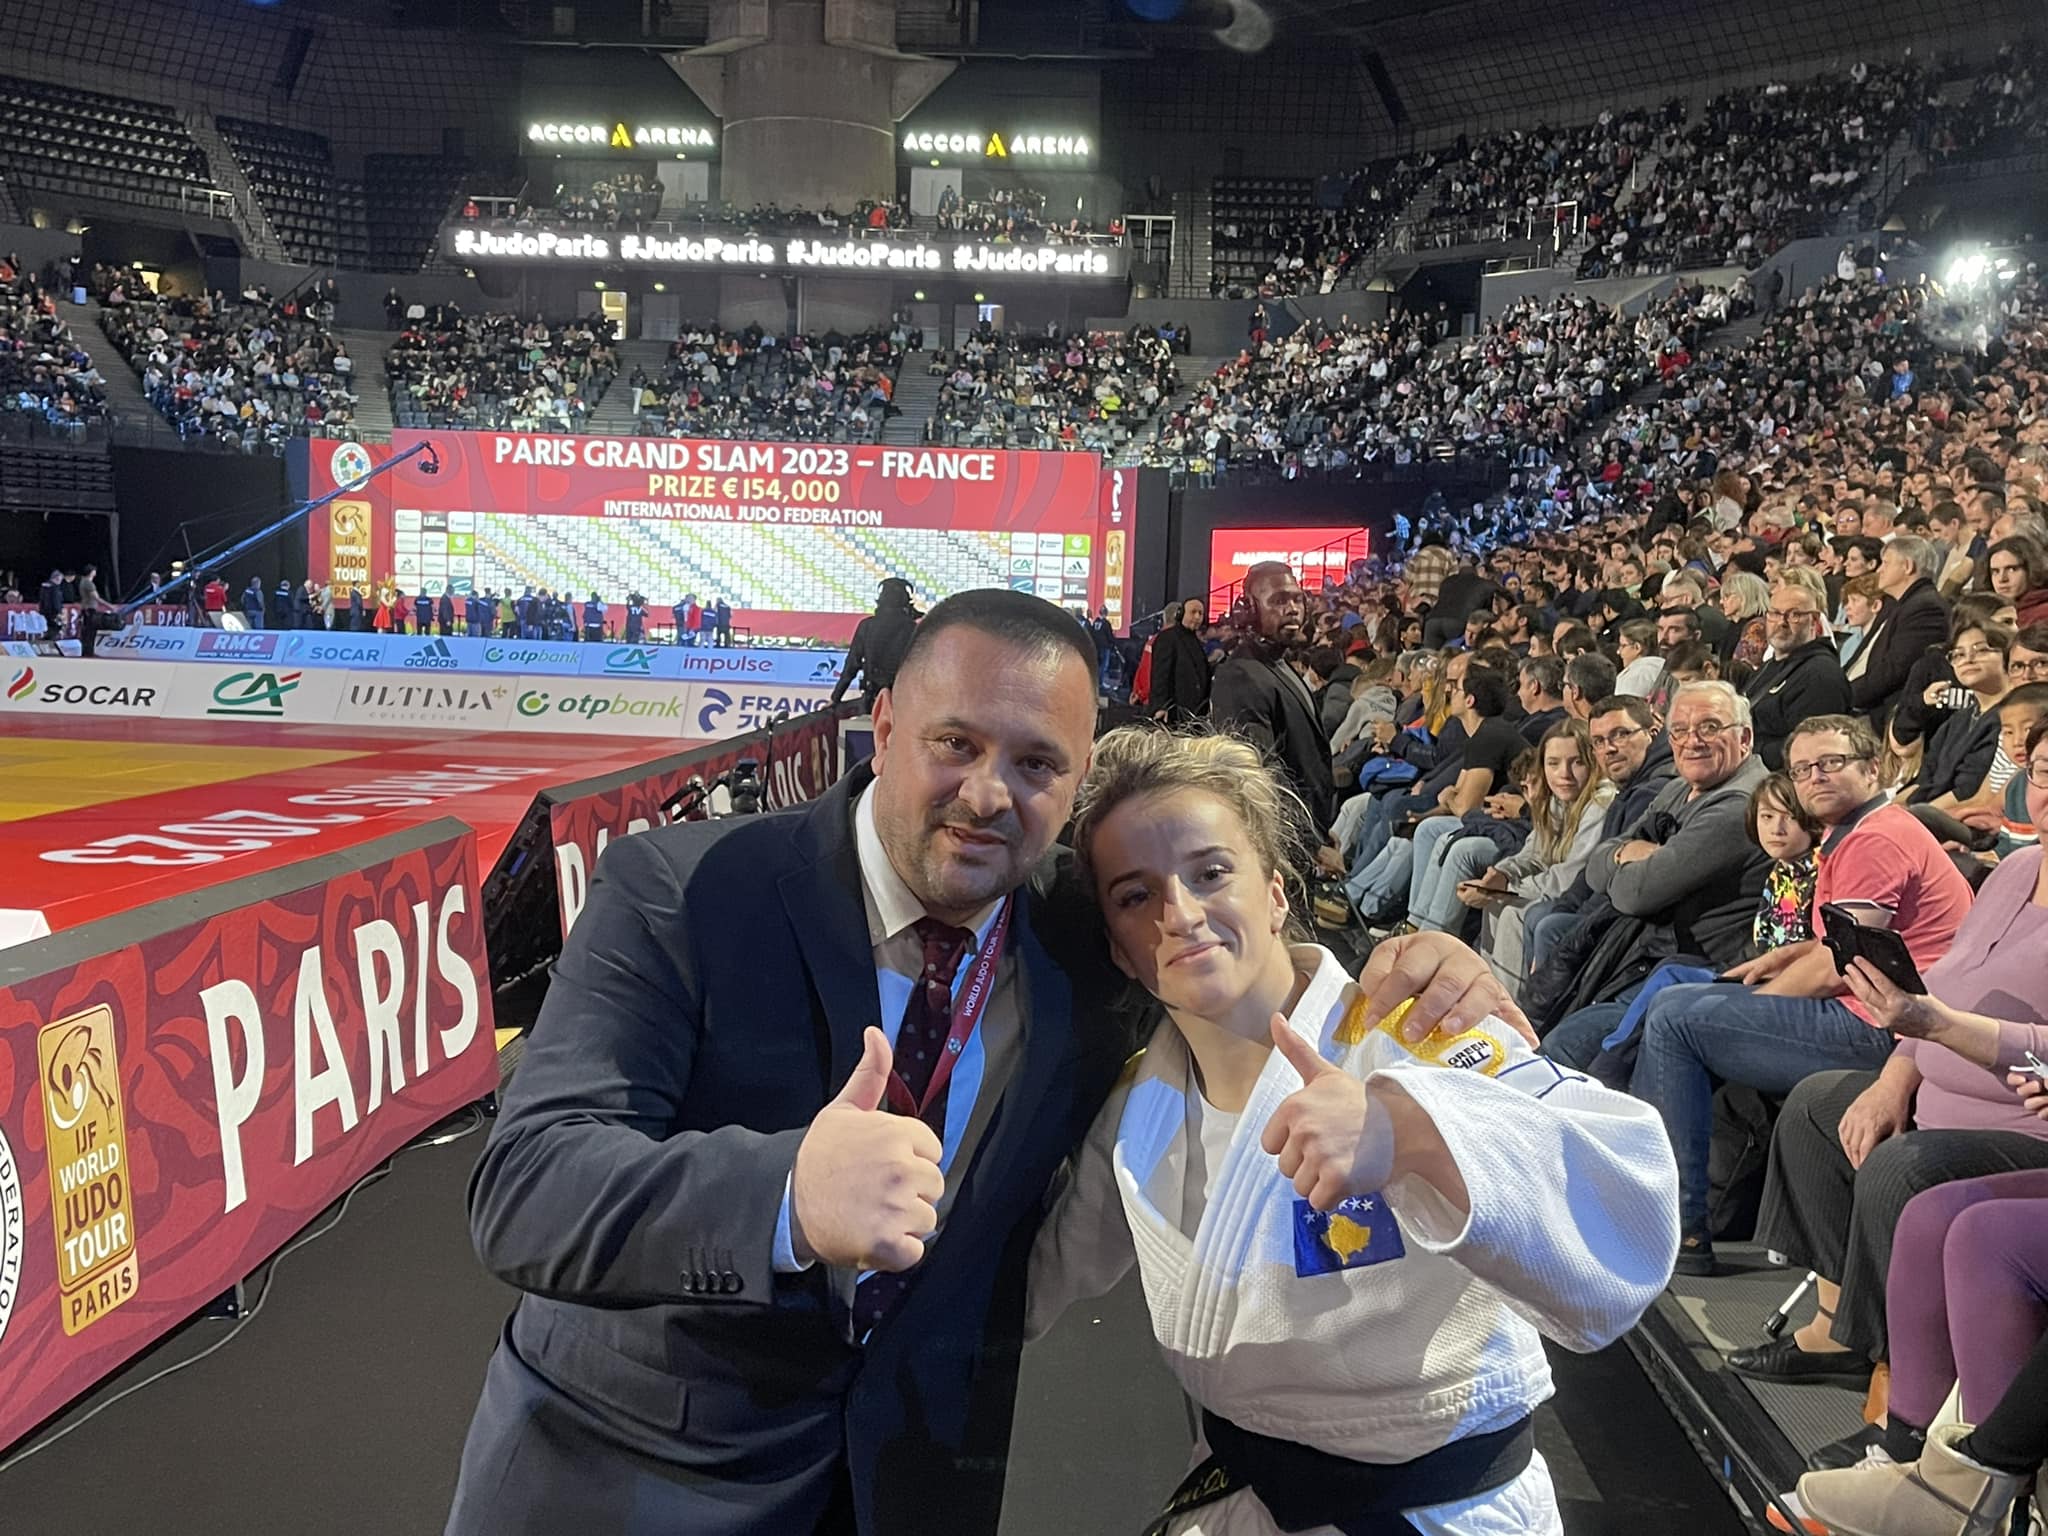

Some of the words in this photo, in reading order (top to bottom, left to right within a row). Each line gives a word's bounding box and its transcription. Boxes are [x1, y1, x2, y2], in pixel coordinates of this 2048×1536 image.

[529, 123, 608, 143] ACCOR
[635, 127, 714, 146] ARENA
[903, 131, 981, 153] ACCOR
[1010, 135, 1090, 155] ARENA
[455, 230, 609, 258] #JudoParis
[620, 235, 775, 264] #JudoParis
[786, 240, 941, 269] #JudoParis
[953, 245, 1108, 273] #JudoParis
[495, 437, 577, 467] PARIS
[583, 440, 690, 471] GRAND
[697, 445, 773, 474] SLAM
[781, 448, 849, 477] 2023
[881, 451, 996, 481] FRANCE
[649, 474, 717, 499] PRIZE
[604, 500, 734, 521] INTERNATIONAL
[737, 505, 781, 522] JUDO
[784, 507, 883, 526] FEDERATION
[335, 556, 367, 569] JUDO
[335, 568, 367, 582] TOUR
[95, 633, 185, 651] TaiShan
[213, 634, 265, 651] RMC
[309, 647, 380, 662] SOCAR
[404, 656, 459, 668] adidas
[683, 653, 774, 674] impulse
[40, 684, 156, 707] SOCAR
[558, 694, 683, 720] otpbank
[963, 983, 981, 1017] WORLD
[975, 960, 990, 985] JUDO
[984, 935, 999, 959] TOUR
[199, 884, 479, 1214] PARIS
[1448, 1039, 1489, 1066] GREEN
[1454, 1050, 1491, 1070] HILL
[75, 1120, 97, 1154] IJF
[59, 1142, 120, 1194] WORLD
[64, 1172, 123, 1238] JUDO
[63, 1211, 128, 1277] TOUR
[71, 1266, 133, 1328] PARIS
